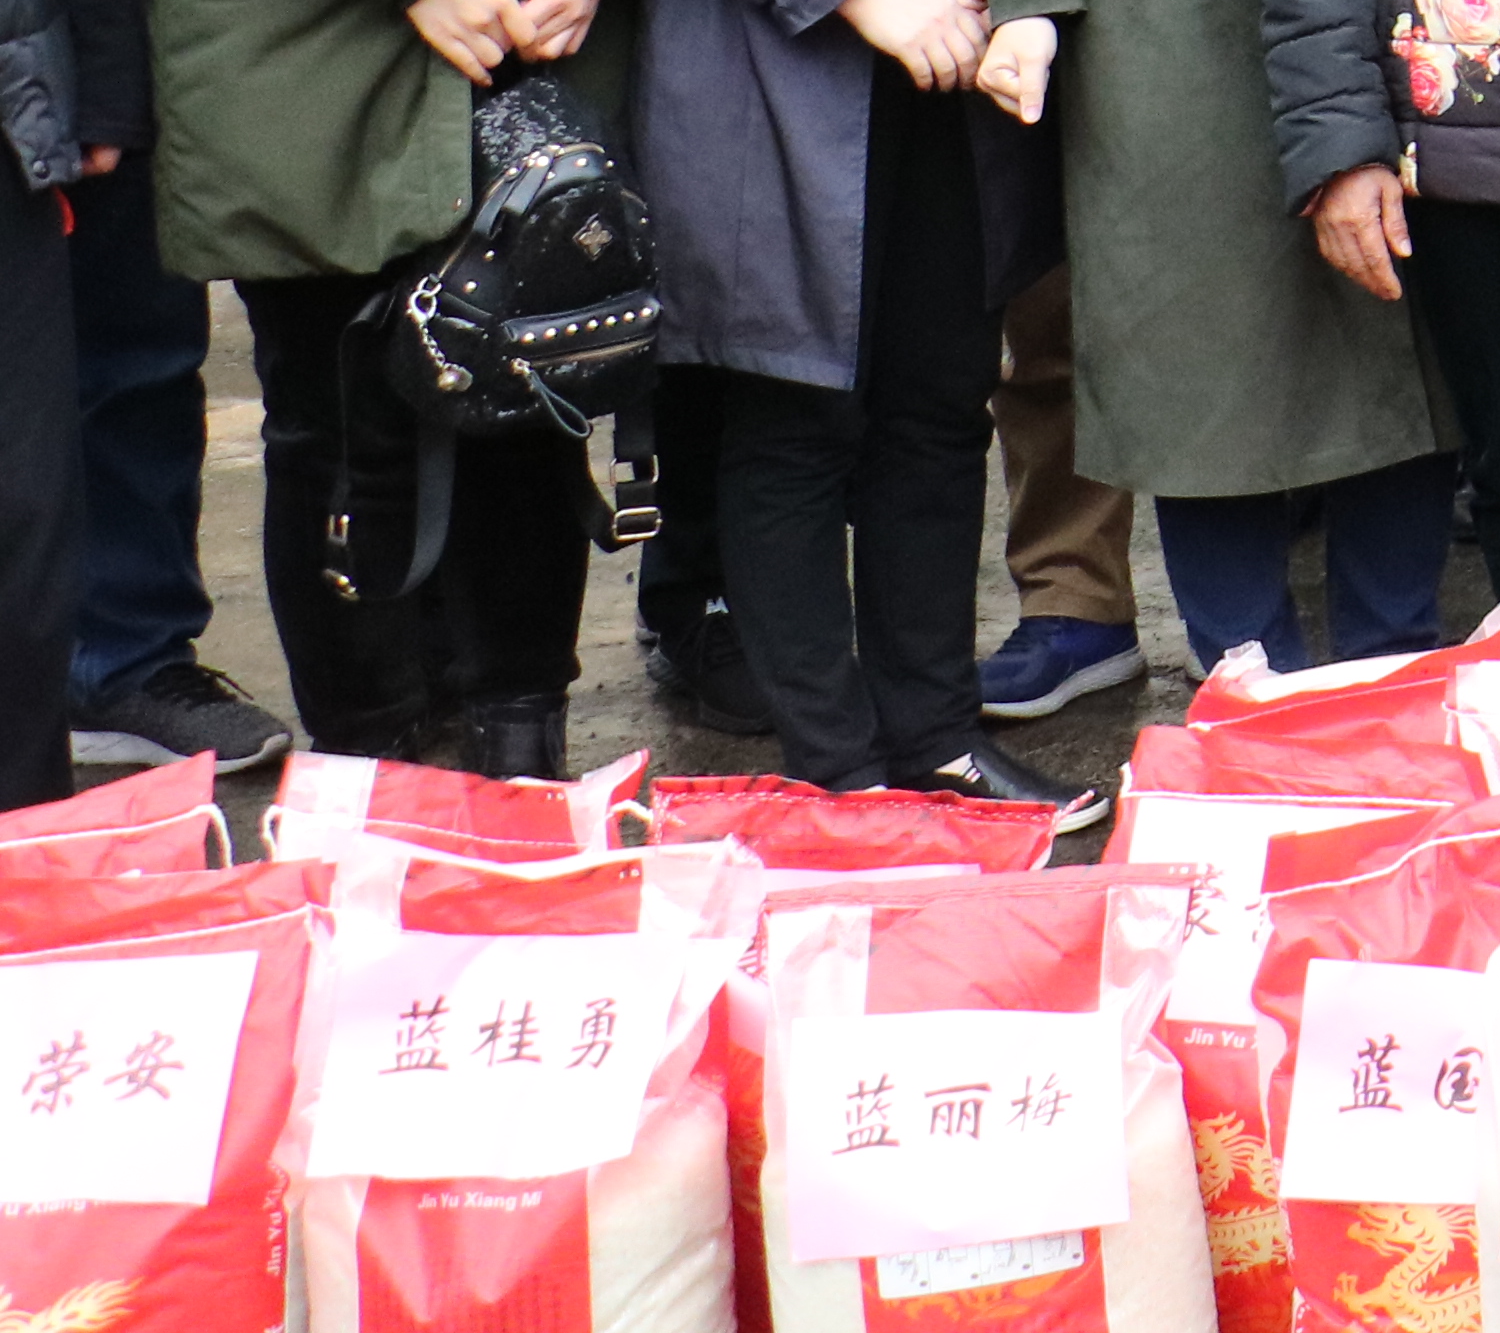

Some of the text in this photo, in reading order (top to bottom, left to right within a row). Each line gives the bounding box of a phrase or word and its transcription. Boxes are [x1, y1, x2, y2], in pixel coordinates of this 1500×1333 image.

[21, 1029, 185, 1116] 荣安
[378, 995, 619, 1075] 蓝桂勇
[1183, 1027, 1246, 1049] Jin Yu
[831, 1073, 1073, 1156] 蓝丽梅
[418, 1190, 542, 1211] Jin Yu Xiang Mi
